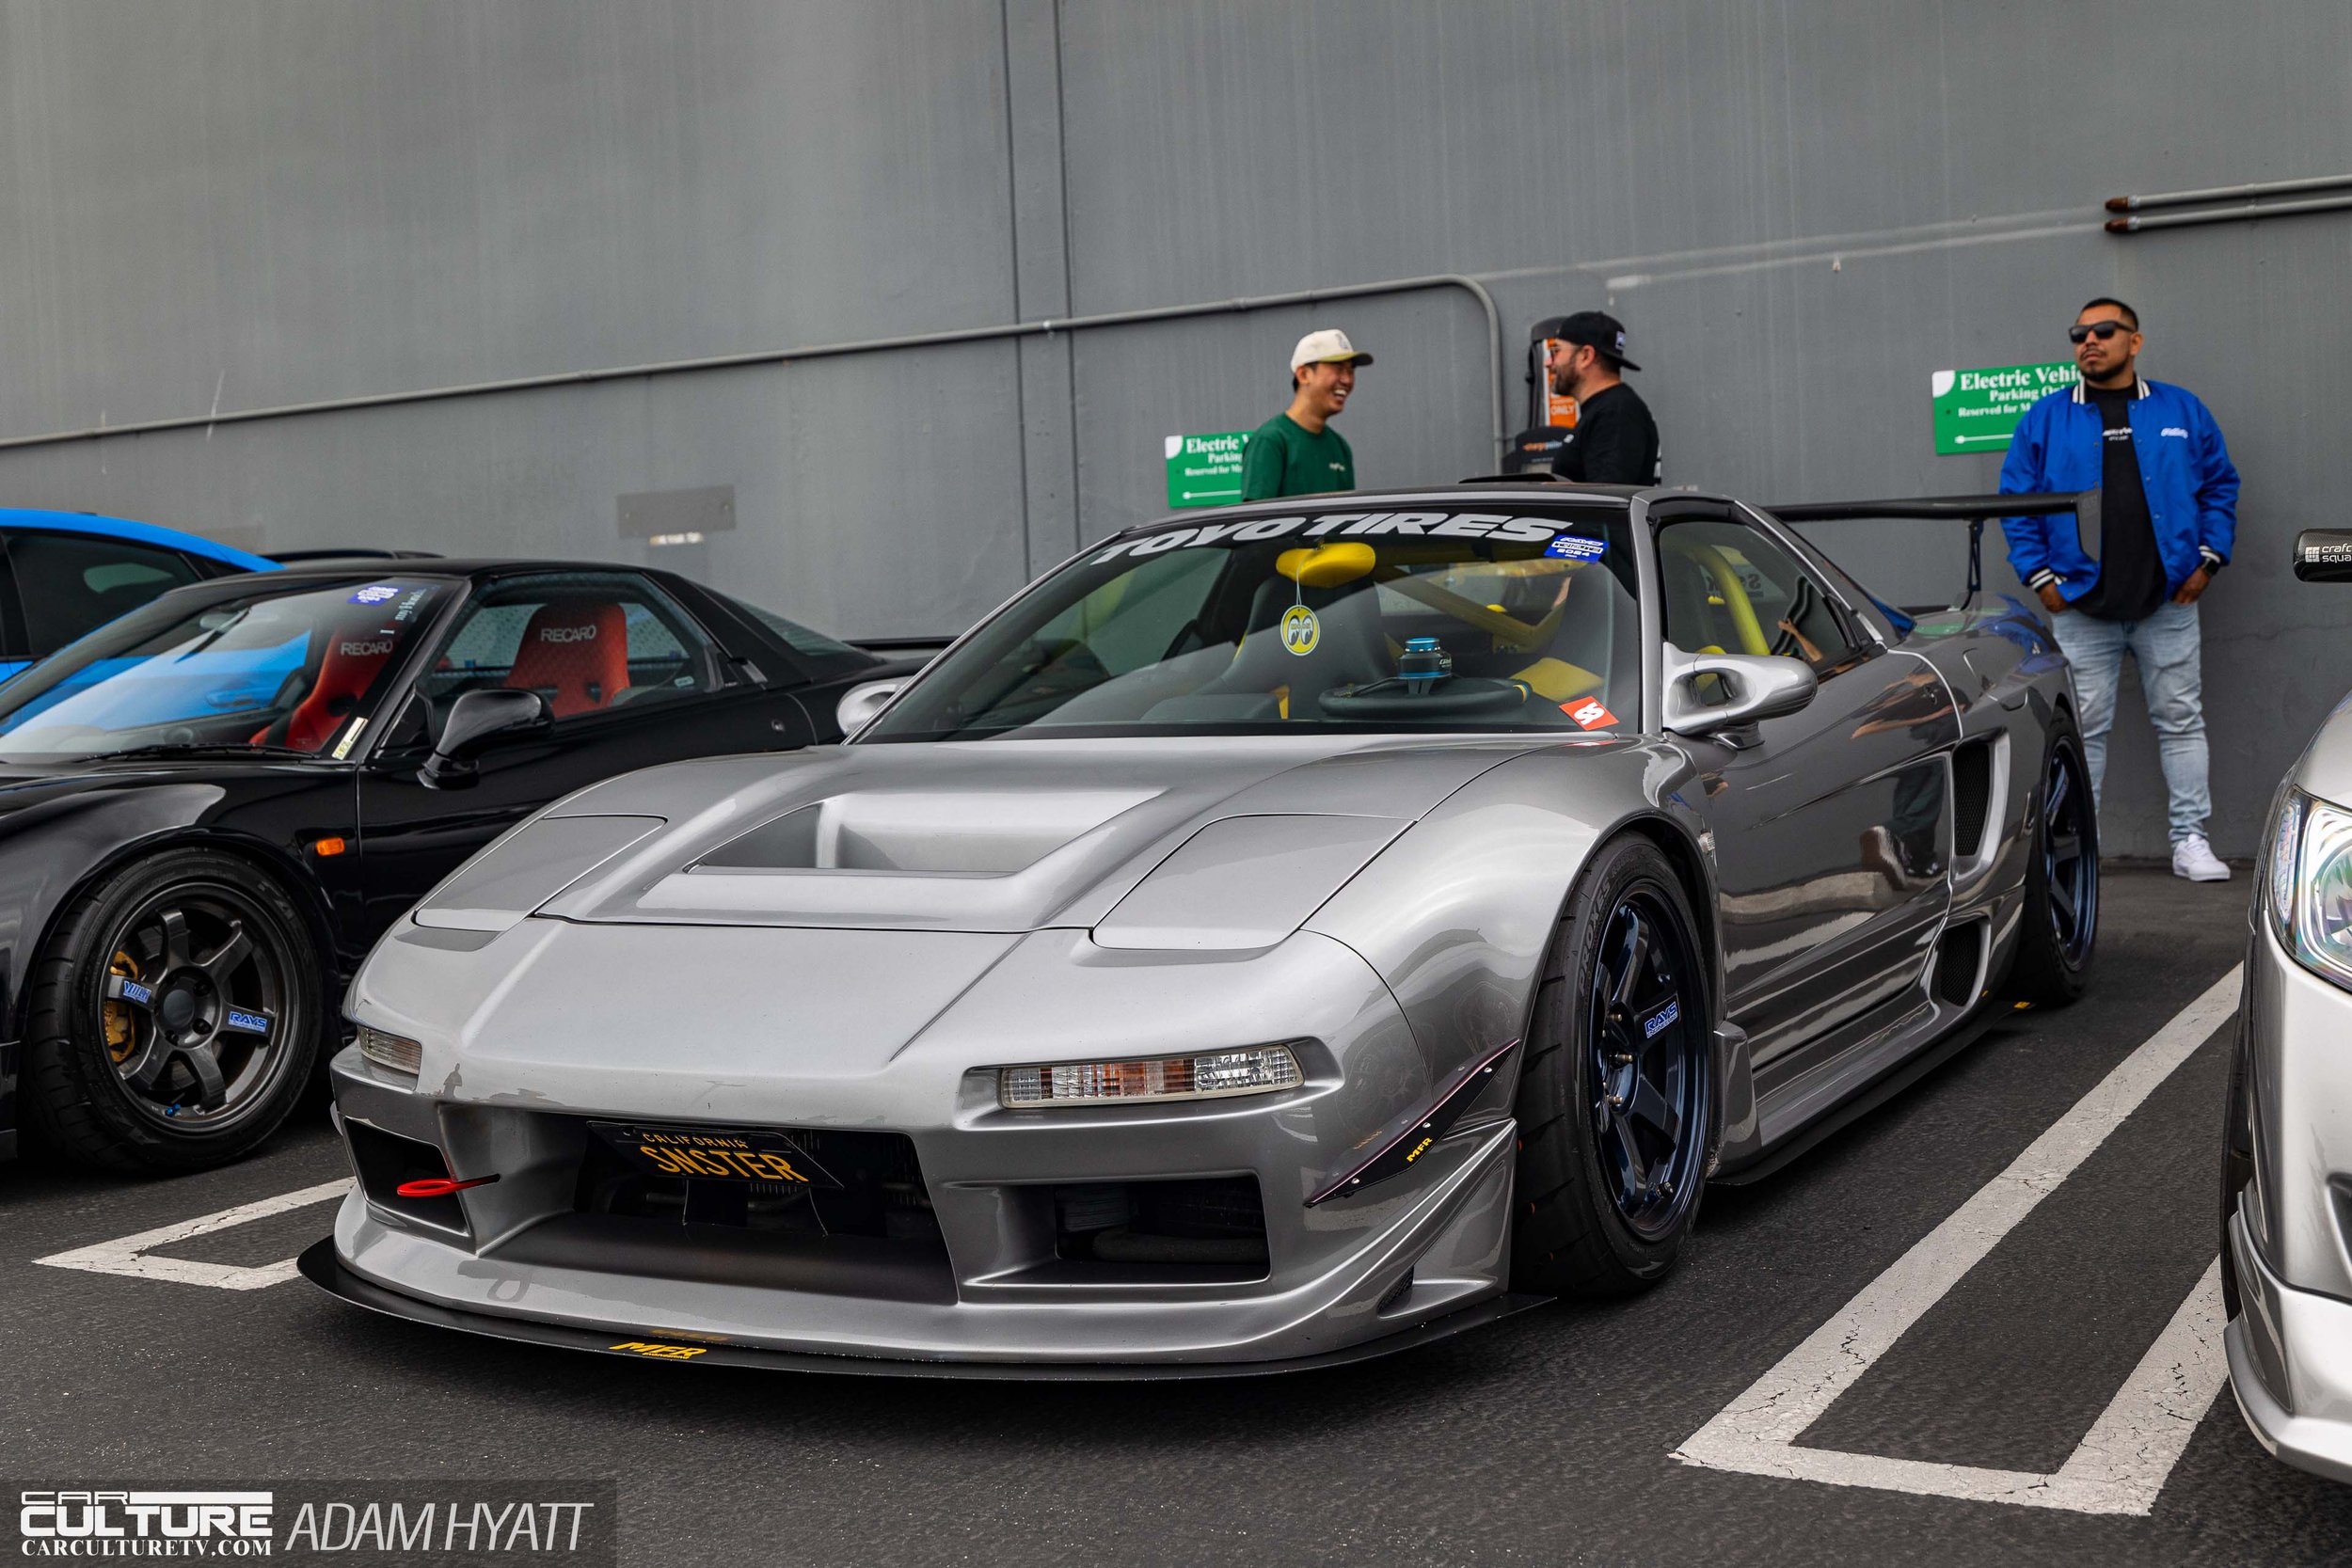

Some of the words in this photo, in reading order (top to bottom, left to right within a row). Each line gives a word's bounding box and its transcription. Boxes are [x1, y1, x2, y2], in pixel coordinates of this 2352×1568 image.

[1961, 369, 2030, 390] Electric
[1989, 388, 2040, 403] Parking
[1550, 404, 1576, 416] ONLY
[1958, 404, 2001, 418] Reserved
[2003, 404, 2018, 414] for
[1186, 435, 1239, 453] Electric
[1089, 516, 1307, 566] TOYO
[1302, 513, 1574, 542] TIRES
[541, 625, 596, 642] RECARO
[341, 640, 393, 656] RECARO
[230, 1011, 267, 1028] RAYS
[1645, 1001, 1677, 1033] RAYS
[643, 1132, 748, 1148] CALIFORNIA
[1406, 1137, 1433, 1162] MFR
[640, 1146, 809, 1182] SNSTER
[609, 1341, 707, 1357] MFR
